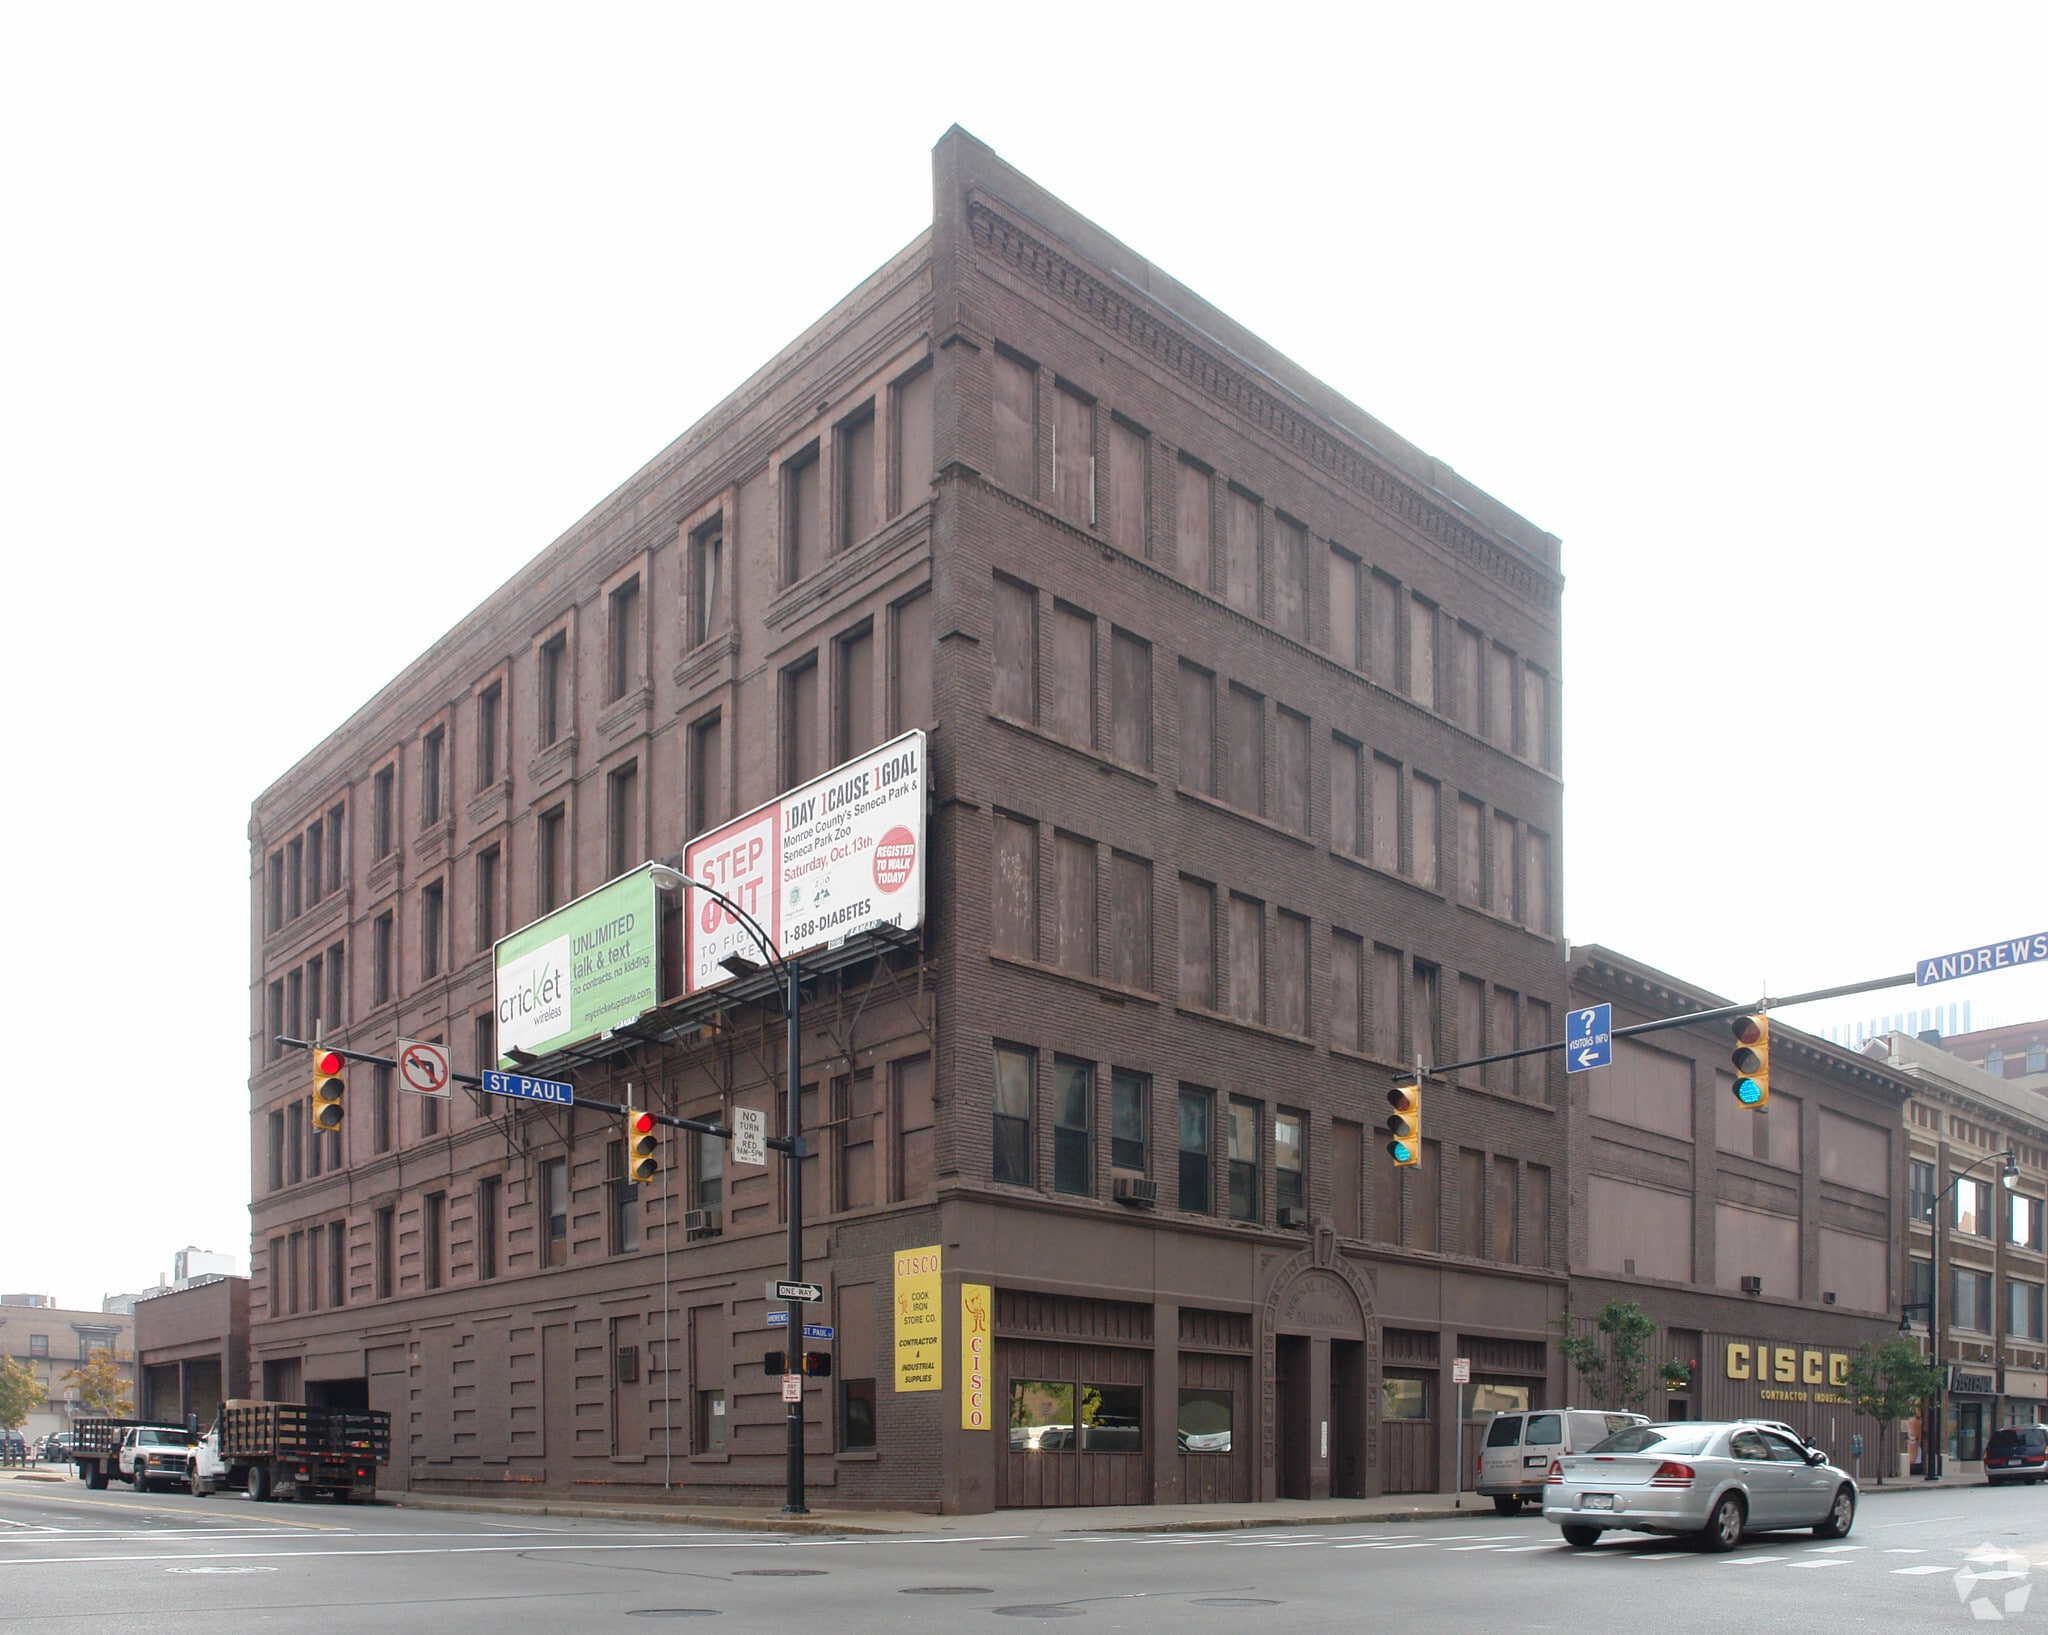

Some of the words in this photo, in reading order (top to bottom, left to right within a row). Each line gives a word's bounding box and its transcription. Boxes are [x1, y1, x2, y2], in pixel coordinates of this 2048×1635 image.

[784, 828, 814, 848] Monroe
[815, 809, 852, 834] County's
[854, 794, 886, 816] Seneca
[888, 782, 909, 801] Park
[912, 780, 918, 790] &
[784, 844, 812, 864] Seneca
[814, 834, 833, 850] Park
[834, 826, 852, 841] Zoo
[877, 844, 914, 858] REGISTER
[702, 837, 764, 890] STEP
[784, 855, 828, 882] Saturday,
[830, 844, 852, 862] Oct.
[852, 836, 873, 853] 13th
[877, 859, 886, 870] TO
[888, 858, 910, 870] WALK
[878, 872, 906, 884] TODAY!
[784, 898, 871, 944] 1-888-DIABETES
[573, 914, 634, 956] UNLIMITED
[724, 922, 762, 950] FIG
[702, 942, 716, 959] TO
[573, 956, 592, 980] talk
[596, 951, 605, 970] &
[608, 941, 630, 964] text
[1924, 936, 2048, 983] ANDREWS
[574, 986, 581, 996] no
[614, 968, 622, 978] no
[500, 961, 562, 1024] cricket
[533, 1005, 562, 1026] wireless
[1569, 1036, 1594, 1050] VISITORS
[1595, 1034, 1608, 1044] INFO
[490, 1074, 514, 1092] ST.
[522, 1079, 566, 1102] PAUL
[742, 1112, 757, 1122] NO
[740, 1122, 759, 1132] TURN
[744, 1132, 754, 1140] ON
[742, 1140, 757, 1150] RED
[898, 1254, 938, 1277] CISCO
[780, 1286, 795, 1295] ONE
[798, 1288, 812, 1297] WAY
[912, 1292, 929, 1300] COOK
[913, 1302, 928, 1311] IRON
[904, 1315, 924, 1325] STORE
[926, 1314, 937, 1322] CO.
[812, 1328, 826, 1337] PAUL
[899, 1336, 938, 1347] CONTRACTOR
[902, 1362, 935, 1372] INDUSTRIAL
[1727, 1343, 1848, 1386] CISCO
[904, 1374, 932, 1384] SUPPLIES
[970, 1337, 982, 1426] CISCO
[1761, 1390, 1808, 1402] CONTRACTOR
[1814, 1393, 1852, 1404] INDUST
